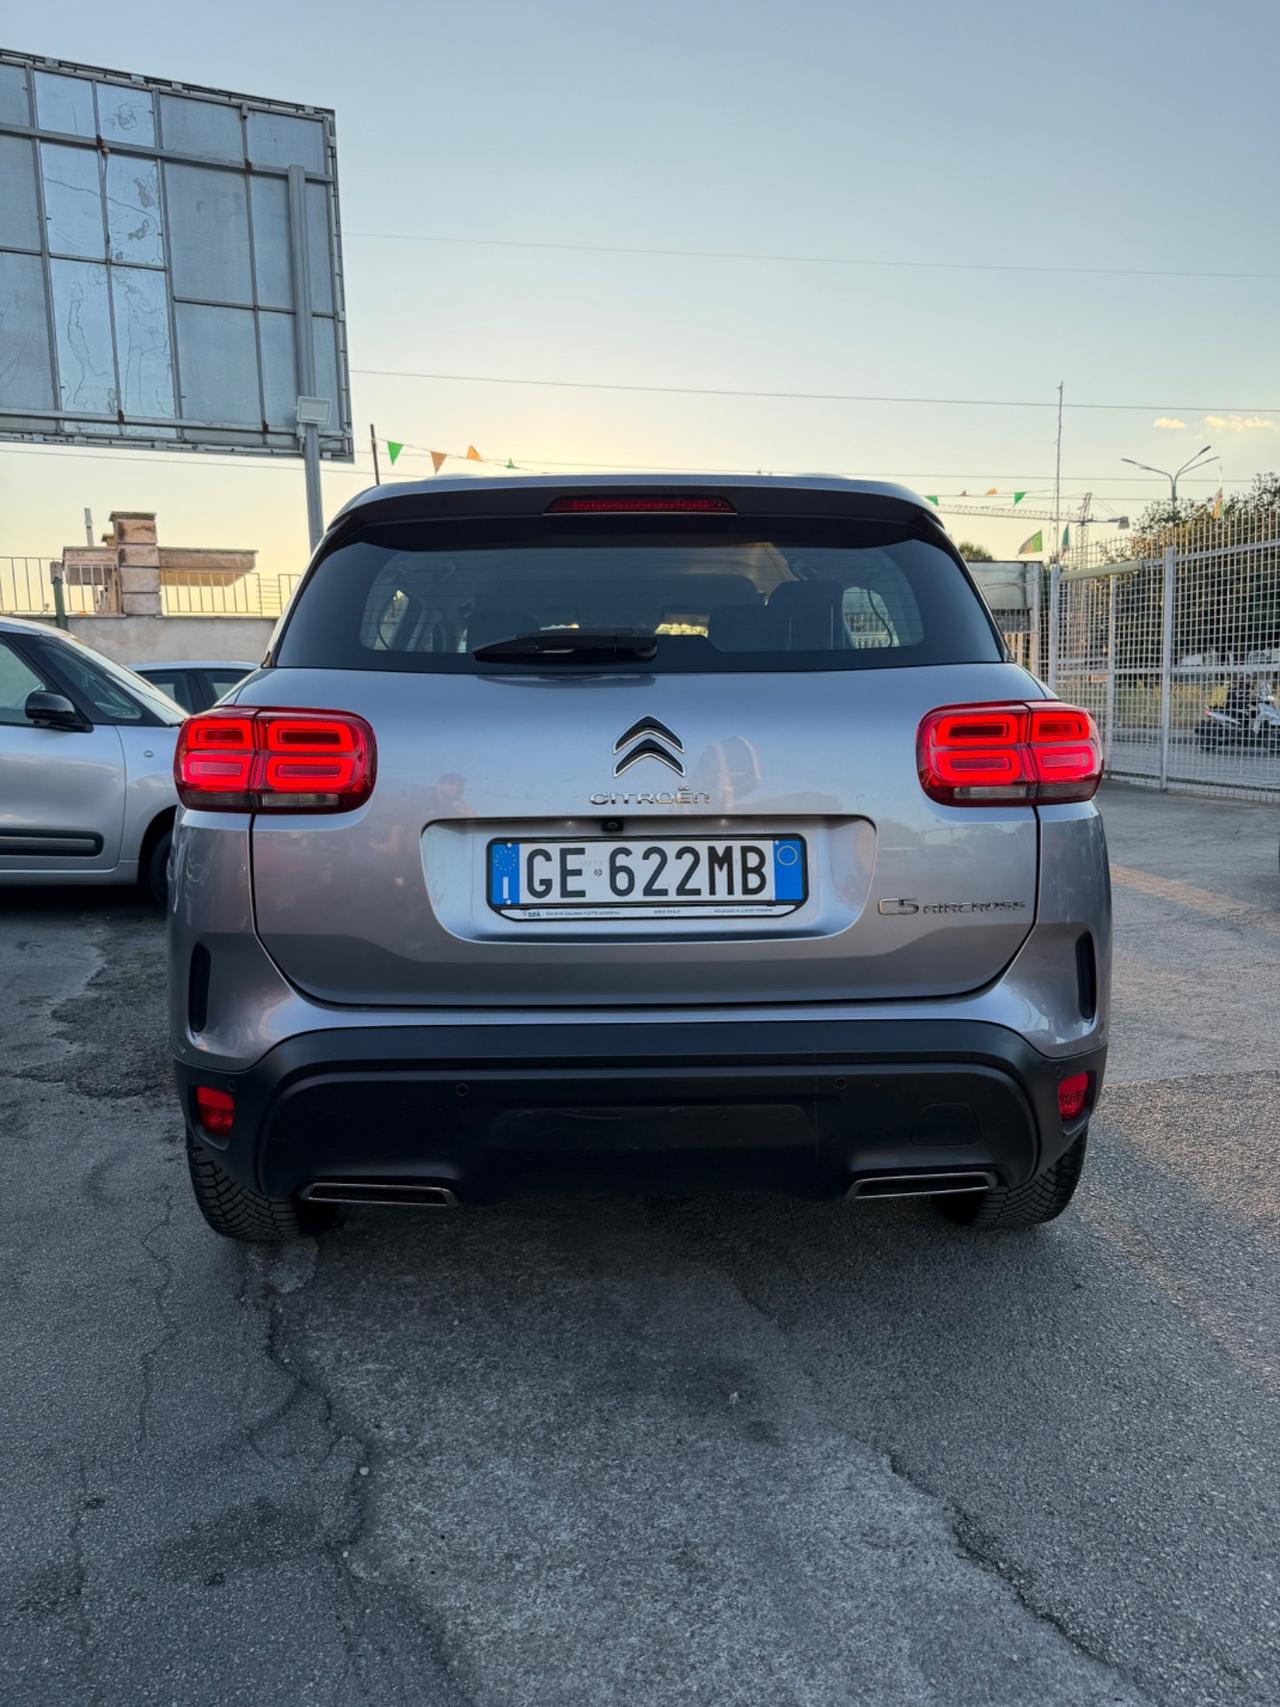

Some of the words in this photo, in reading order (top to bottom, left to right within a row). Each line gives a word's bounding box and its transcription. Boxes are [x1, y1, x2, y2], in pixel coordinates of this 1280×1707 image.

[526, 847, 587, 899] GE
[608, 845, 767, 898] 622MB
[877, 897, 919, 916] C5
[922, 900, 1025, 915] AIRCROSS
